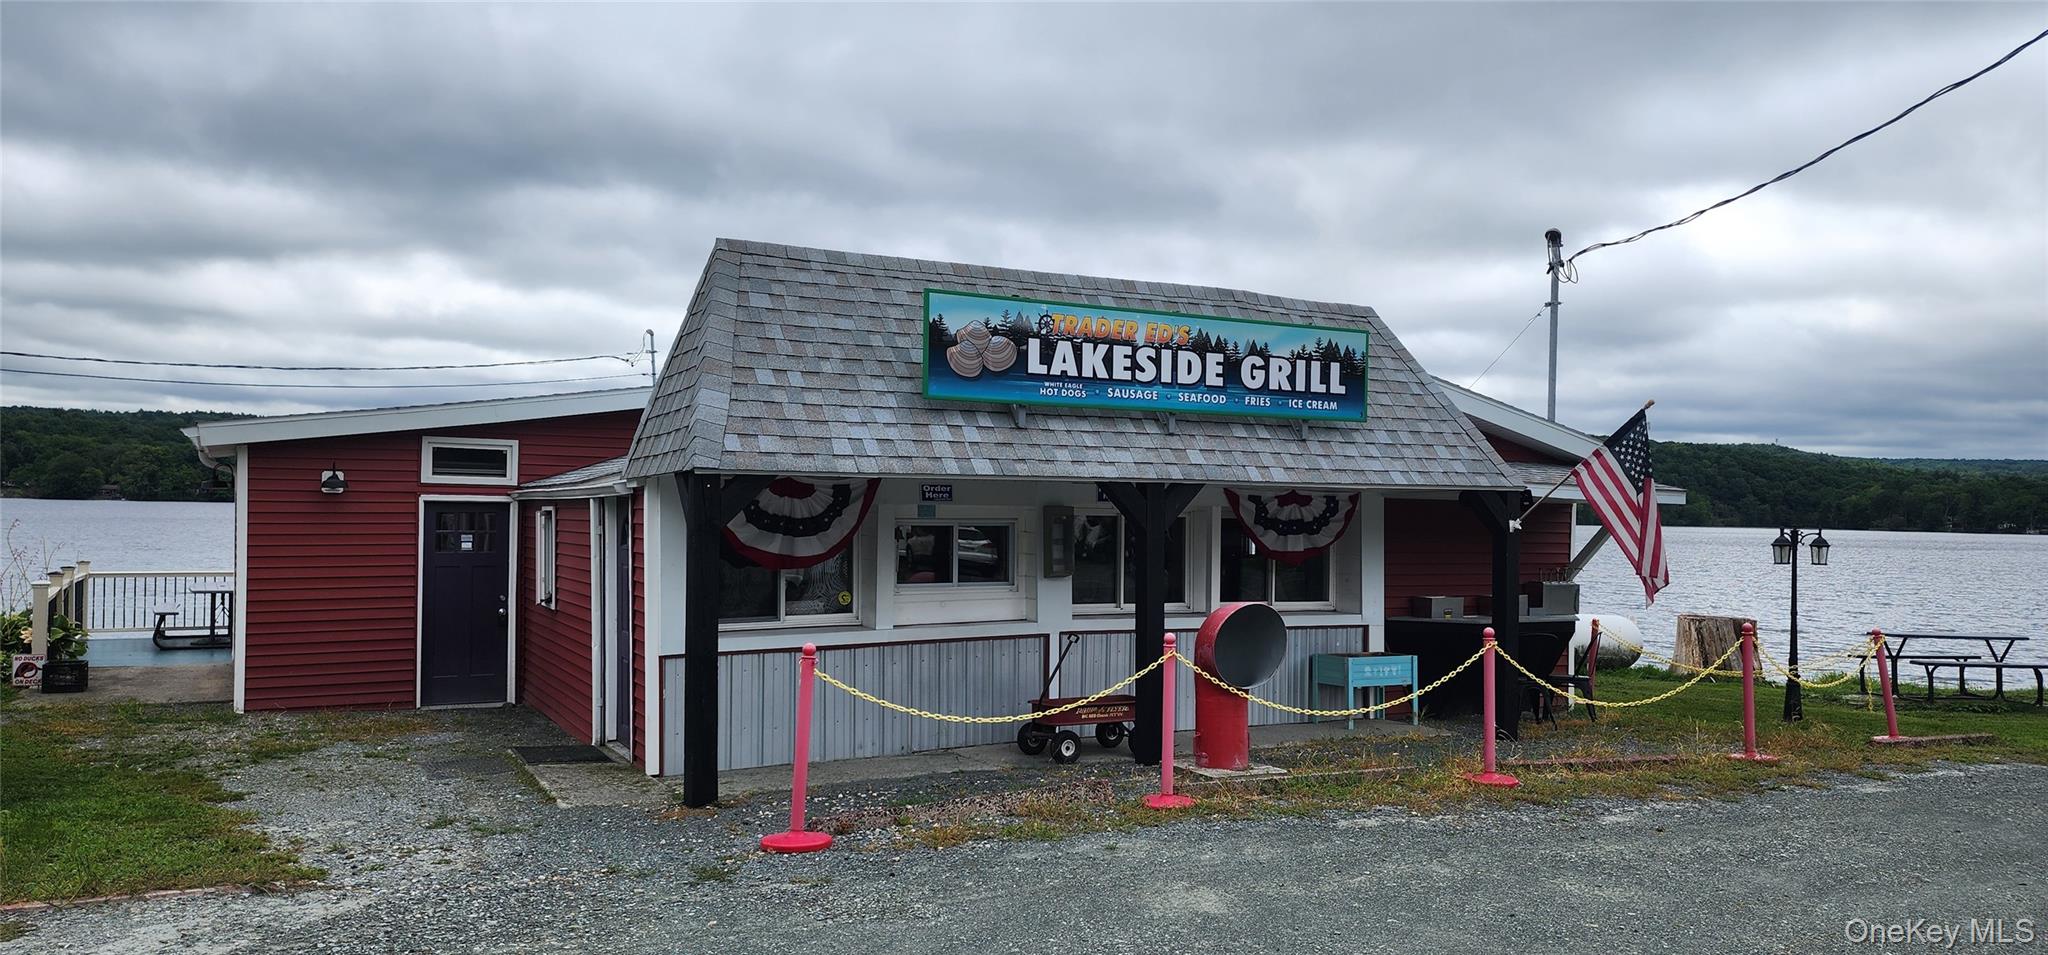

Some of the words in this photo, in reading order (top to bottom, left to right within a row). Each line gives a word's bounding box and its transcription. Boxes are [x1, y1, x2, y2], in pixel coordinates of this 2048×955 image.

[1052, 313, 1138, 341] TRADER
[1144, 322, 1190, 346] ED'S
[1027, 337, 1224, 387] LAKESIDE
[1240, 355, 1346, 394] GRILL
[1040, 387, 1058, 396] HOT
[1061, 389, 1087, 398] DOGS
[1107, 387, 1158, 400] SAUSAGE
[1178, 392, 1227, 404] SEAFOOD
[1245, 396, 1271, 407] FRIES
[1289, 399, 1303, 409] ICE
[1306, 400, 1338, 410] CREAM
